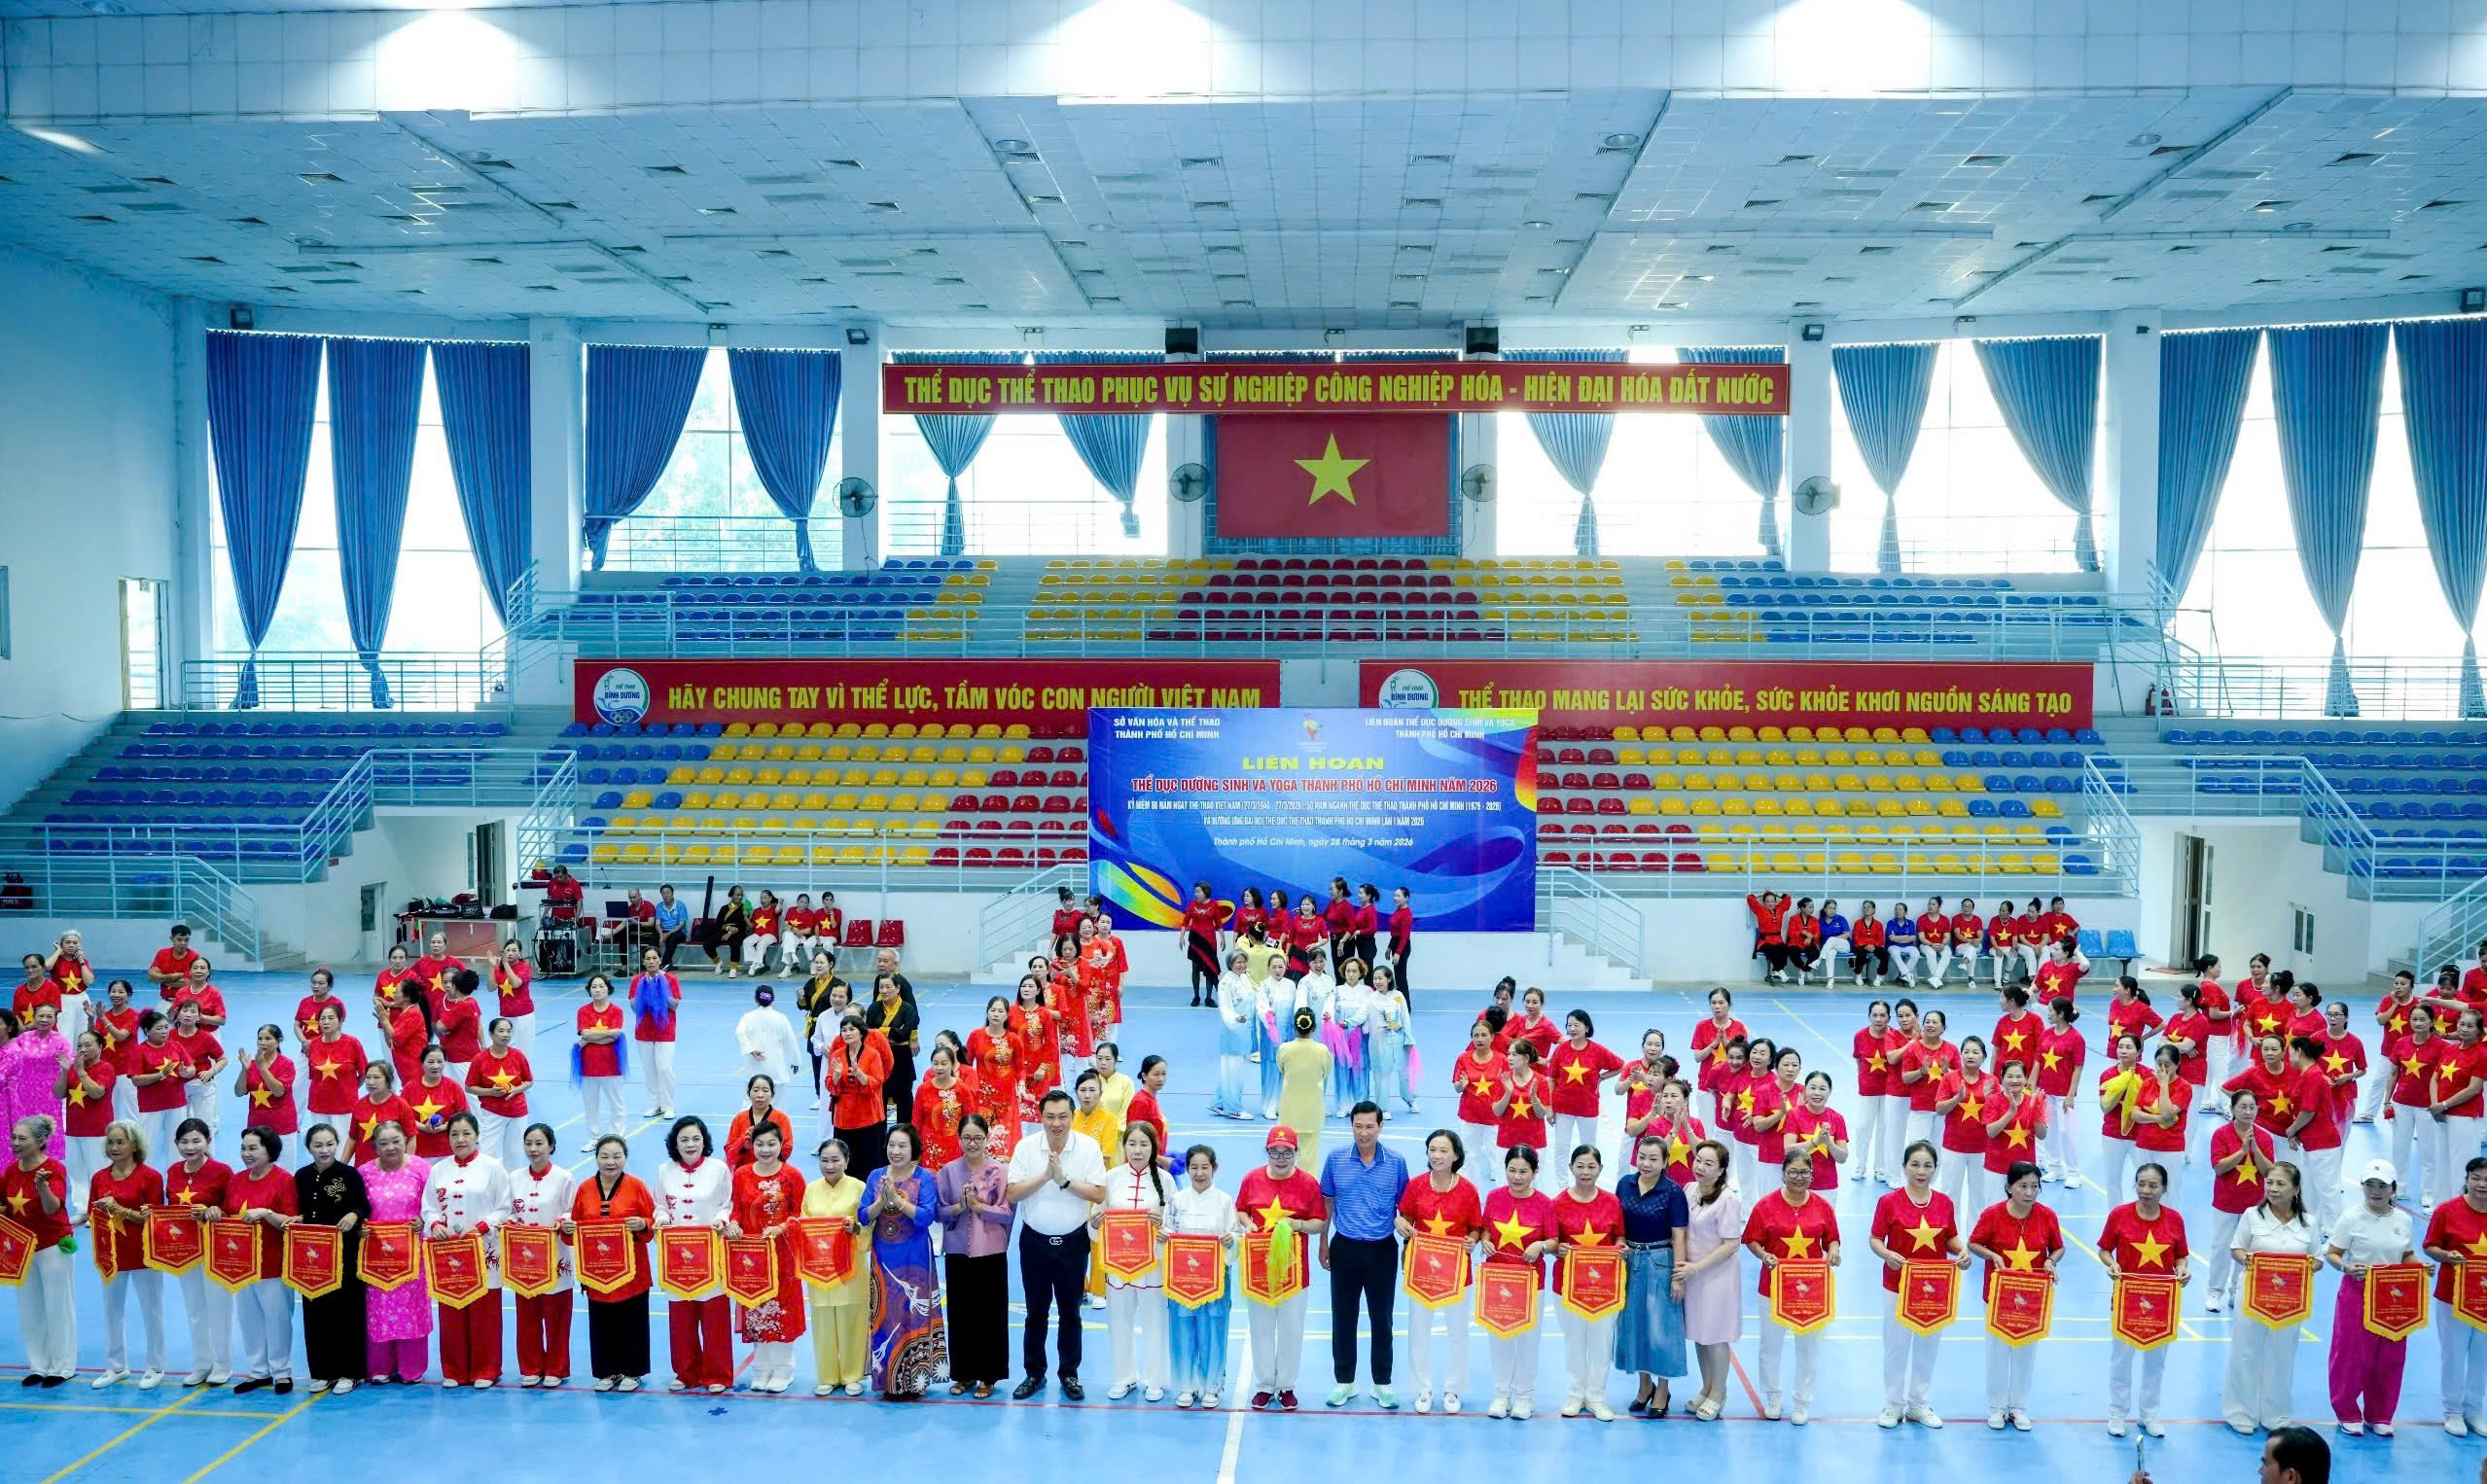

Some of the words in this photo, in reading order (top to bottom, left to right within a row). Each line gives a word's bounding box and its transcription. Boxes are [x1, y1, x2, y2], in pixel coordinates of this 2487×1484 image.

[905, 369, 942, 404] THỂ
[948, 377, 991, 408] DỤC
[998, 369, 1036, 404] THỂ
[1042, 376, 1095, 404] THAO
[1102, 376, 1157, 407] PHỤC
[1165, 375, 1192, 406] VỤ
[1199, 372, 1228, 406] SỰ
[1234, 371, 1308, 406] NGHIỆP
[1315, 371, 1372, 403] CÔNG
[1379, 371, 1454, 406] NGHIỆP
[1461, 371, 1504, 402] HÓA
[1524, 371, 1571, 406] HIỆN
[1579, 376, 1614, 407] ĐẠI
[1621, 372, 1663, 403] HÓA
[1669, 369, 1710, 404] ĐẤT
[1716, 372, 1774, 405] NƯỚC
[668, 683, 707, 709] HÃY
[714, 687, 781, 710] CHUNG
[787, 687, 819, 709] TAY
[826, 682, 844, 709] VÌ
[851, 678, 889, 709] THỂ
[895, 684, 939, 714] LỰC,
[944, 679, 988, 710] TẦM
[994, 683, 1035, 710] VÓC
[1042, 687, 1084, 710] CON
[1090, 682, 1155, 708] NGƯỜI
[1211, 688, 1261, 708] NAM
[1459, 682, 1494, 708] THỂ
[1499, 689, 1546, 710] THAO
[1553, 689, 1610, 711] MANG
[1616, 689, 1645, 715] LẠI
[1651, 686, 1688, 711] SỨC
[1695, 684, 1751, 713] KHỎE,
[1756, 686, 1794, 711] SỨC
[1799, 685, 1849, 712] KHỎE
[1856, 689, 1900, 712] KHƠI
[1906, 686, 1972, 713] NGUỒN
[1977, 688, 2030, 713] SÁNG
[2036, 692, 2073, 718] TẠO
[1167, 716, 1179, 726] VÀ
[1198, 718, 1221, 726] THAO
[1464, 718, 1483, 726] SINH
[1496, 718, 1515, 726] YOGA
[1179, 728, 1194, 739] CHÍ
[1196, 730, 1220, 739] MINH
[1464, 730, 1485, 739] MINH
[1242, 755, 1299, 770] LIÊN
[1309, 757, 1385, 770] HOAN
[1131, 774, 1154, 792] THỂ
[1155, 778, 1179, 794] DỤC
[1181, 776, 1219, 793] DƯỠNG
[1222, 778, 1250, 793] SINH
[1252, 777, 1266, 792] VÀ
[1269, 778, 1298, 793] YOGA
[1301, 776, 1338, 793] THÀNH
[1384, 776, 1403, 793] CHÍ
[1406, 778, 1438, 793] MINH
[1439, 776, 1467, 793] NĂM
[1469, 778, 1498, 793] 2026
[1450, 800, 1464, 810] MINH
[1411, 816, 1425, 826] 2026
[1342, 837, 1366, 848] tháng
[1367, 837, 1372, 846] 3
[1394, 837, 1414, 846] 2026
